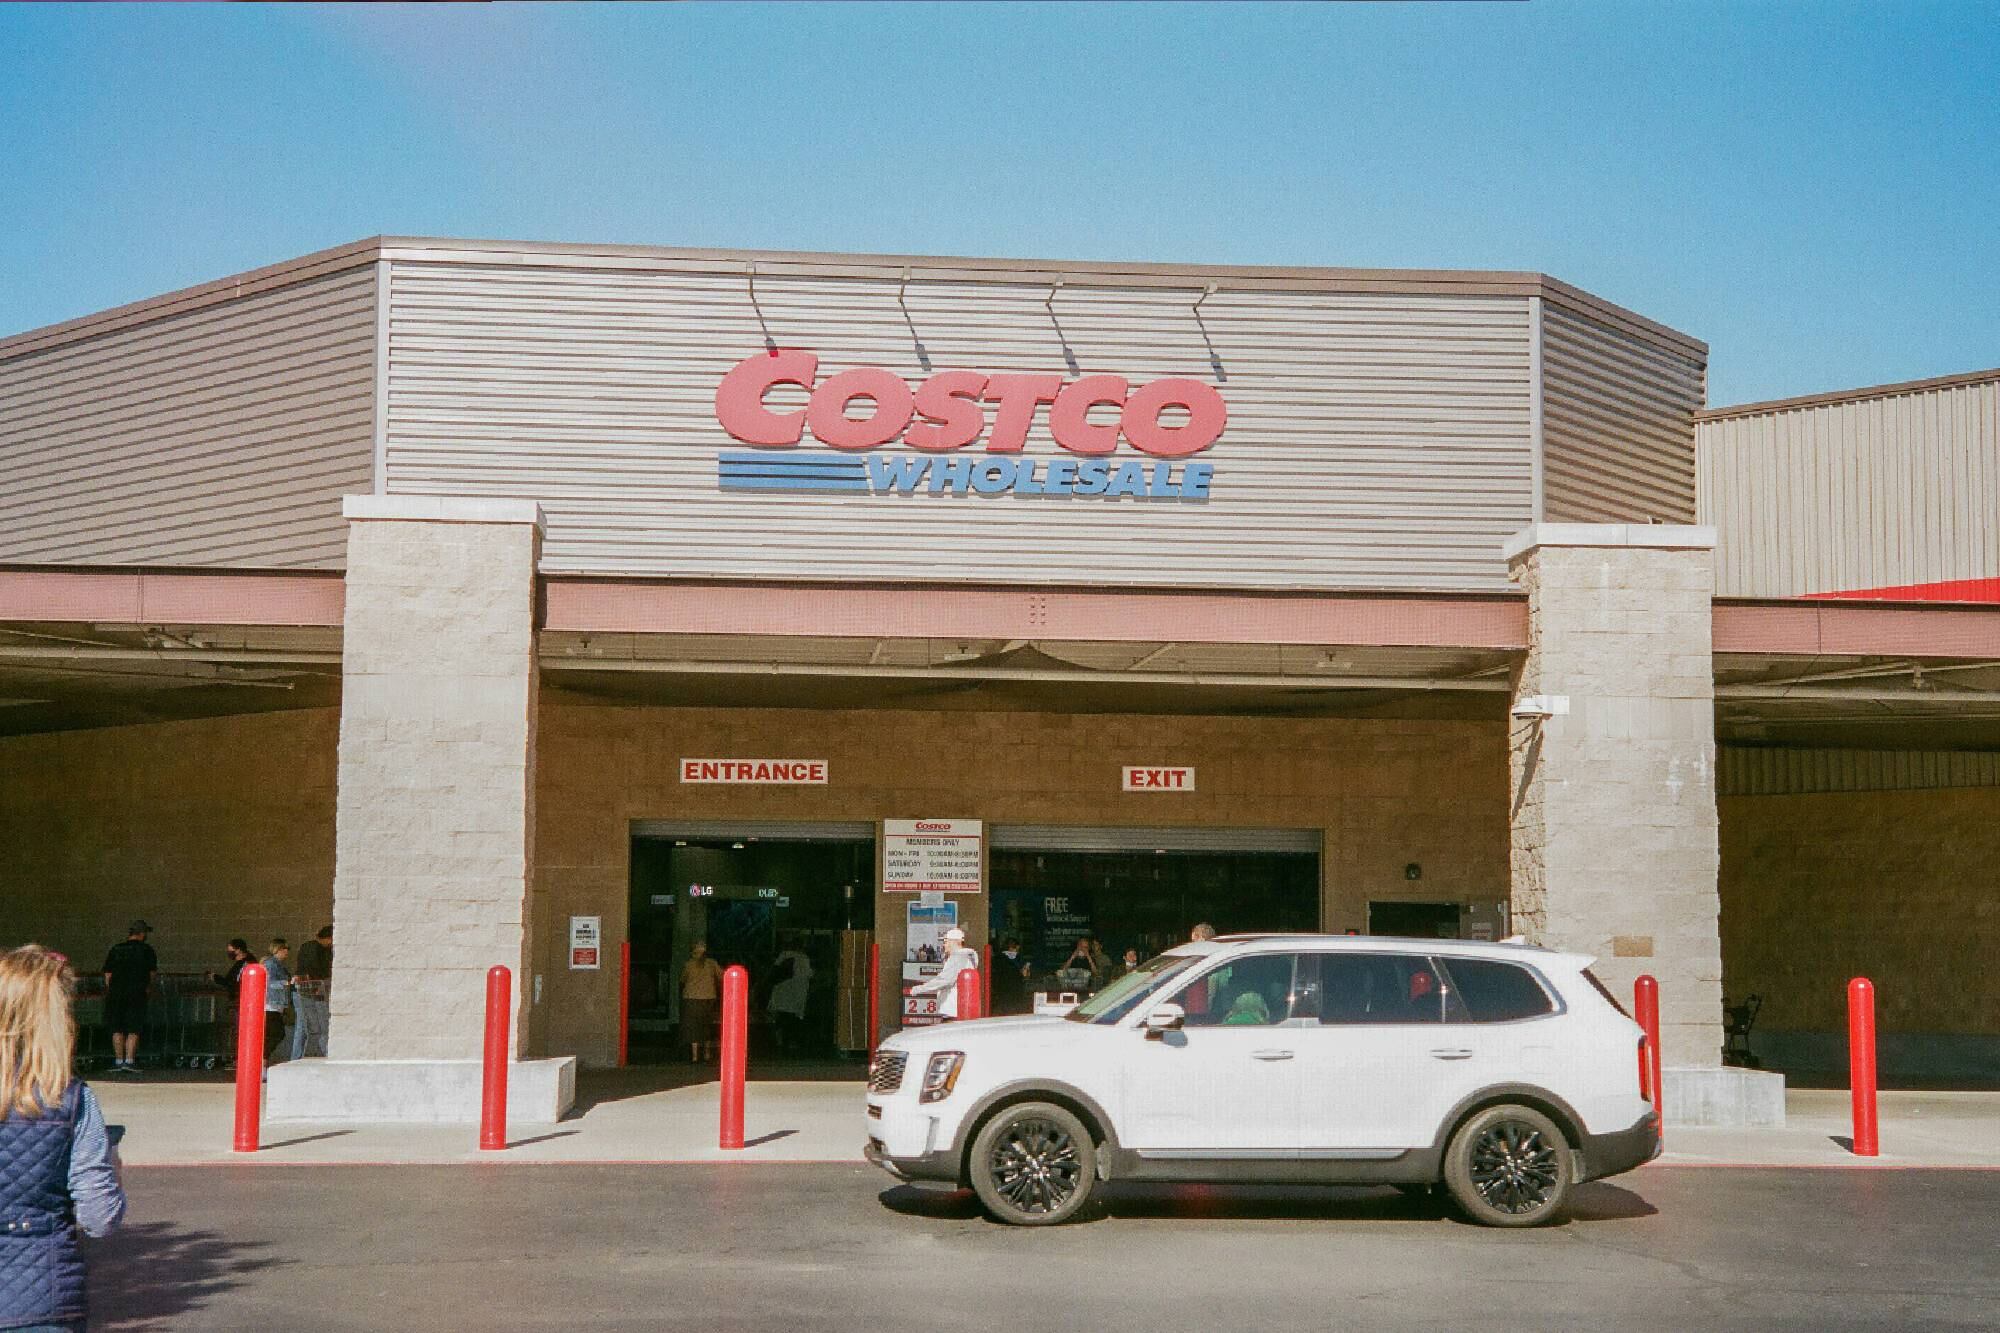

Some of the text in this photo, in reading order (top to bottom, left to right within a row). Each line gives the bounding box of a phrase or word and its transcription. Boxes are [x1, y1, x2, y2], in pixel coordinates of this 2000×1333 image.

[715, 349, 1227, 456] COSTCO
[868, 455, 1214, 499] WHOLESALE
[685, 762, 824, 780] ENTRANCE
[1130, 770, 1186, 787] EXIT
[1045, 897, 1068, 913] FREE
